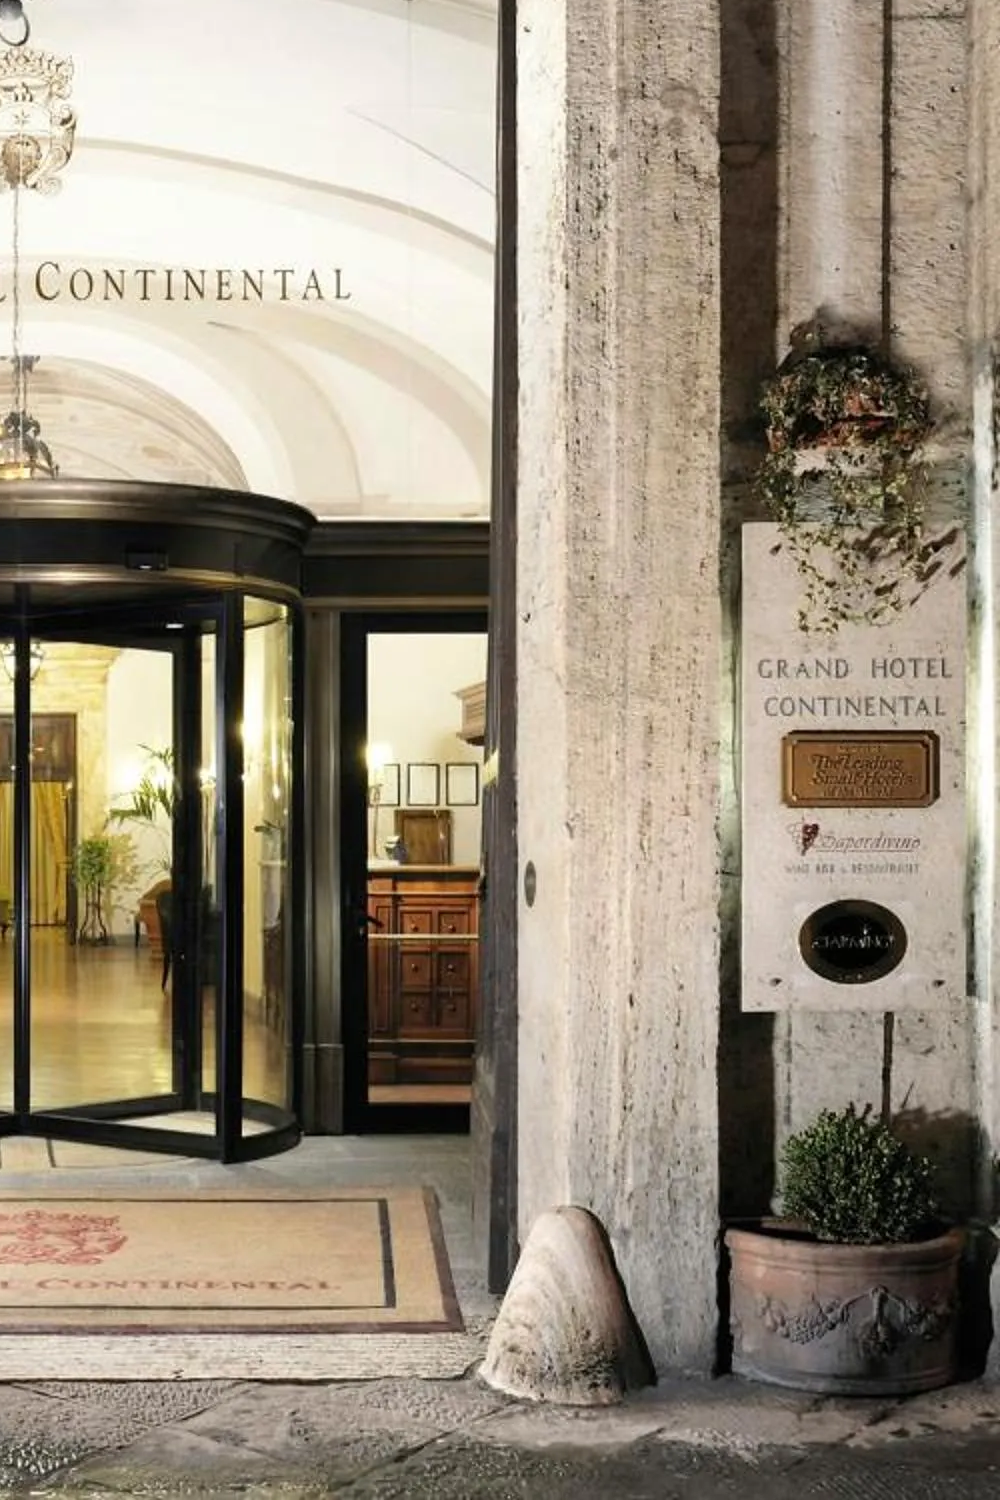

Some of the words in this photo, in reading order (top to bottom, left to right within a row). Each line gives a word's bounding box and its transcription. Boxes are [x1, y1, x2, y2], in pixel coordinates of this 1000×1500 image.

[34, 260, 352, 302] CONTINENTAL
[757, 657, 850, 680] GRAND
[870, 657, 953, 680] HOTEL
[763, 695, 947, 718] CONTINENTAL
